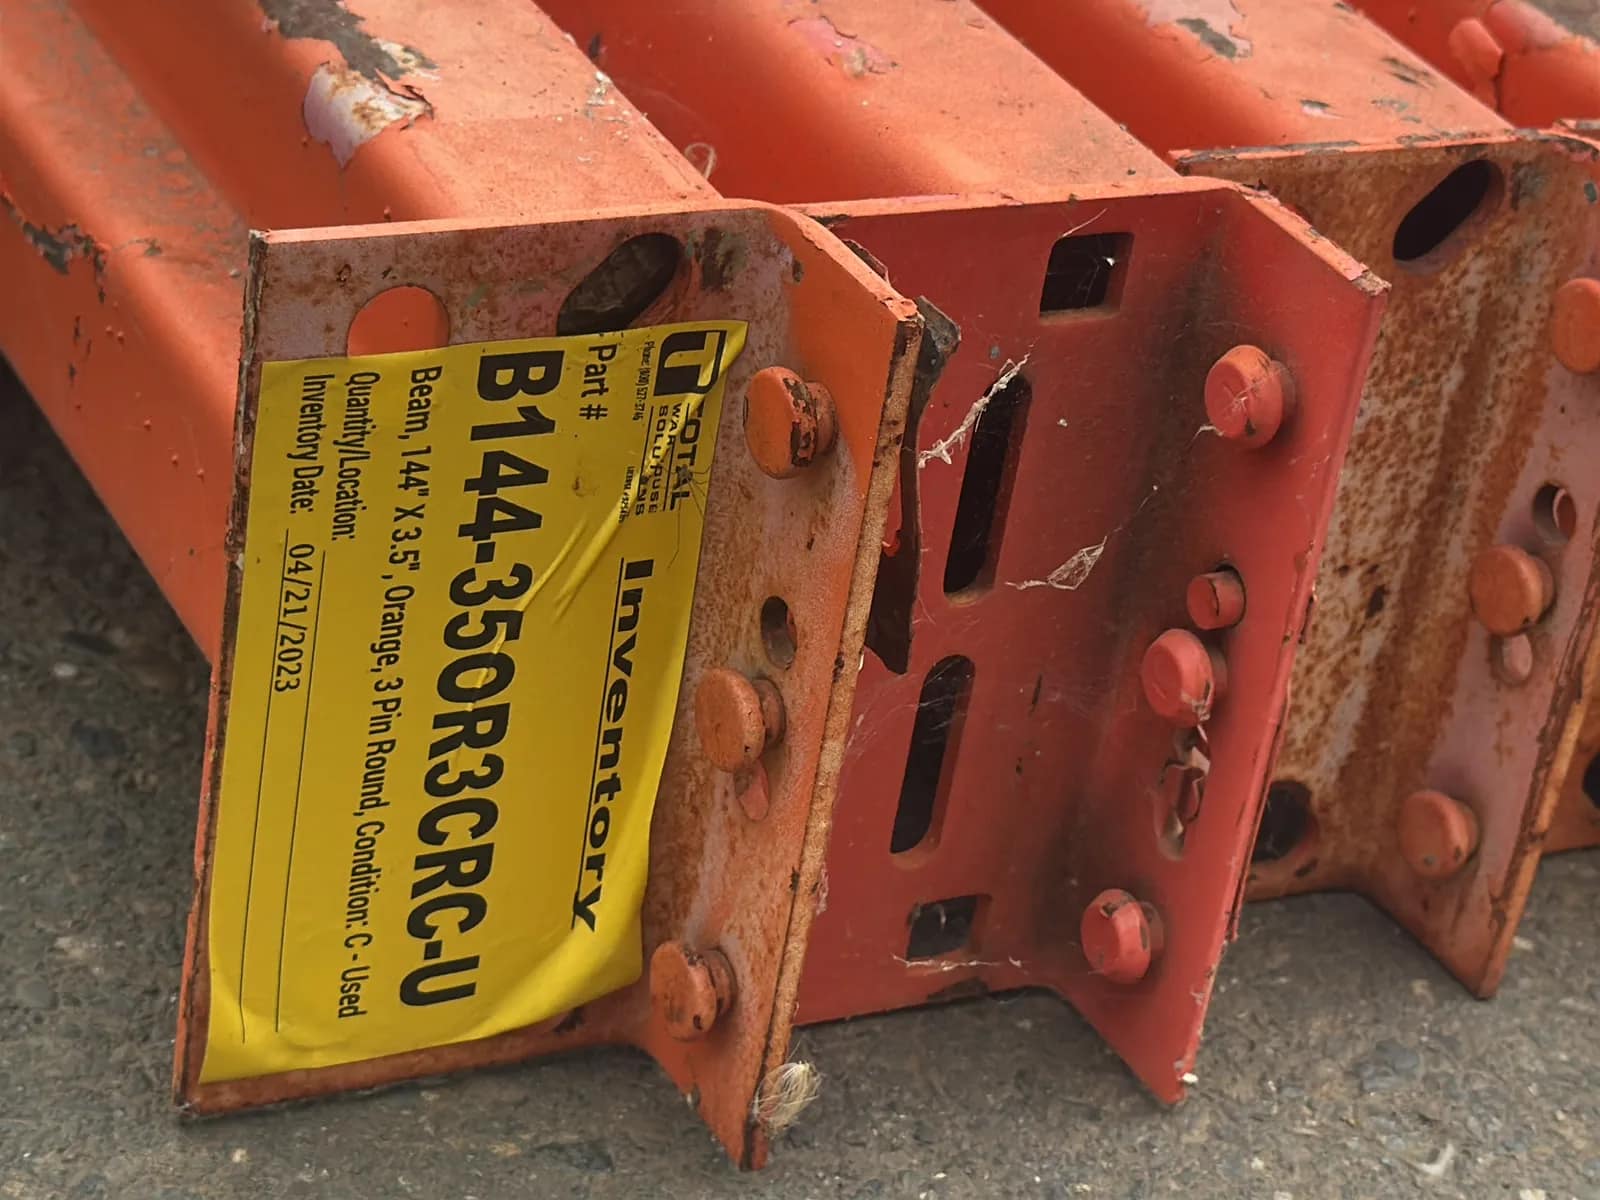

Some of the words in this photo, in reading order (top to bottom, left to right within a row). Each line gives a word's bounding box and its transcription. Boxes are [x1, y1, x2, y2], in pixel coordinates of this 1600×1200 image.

[578, 344, 618, 401] Part
[286, 374, 334, 462] Inventory
[398, 365, 443, 441] Beam,
[579, 403, 608, 421] #
[328, 371, 381, 541] Quantity/Location:
[393, 446, 432, 497] 144"
[288, 466, 324, 514] Date:
[391, 506, 423, 522] X
[272, 542, 318, 694] 04/21/2023
[369, 585, 414, 673] Orange,
[373, 679, 403, 693] 3
[366, 699, 403, 735] Pin
[572, 558, 655, 932] Inventory
[353, 741, 396, 818] Round,
[344, 821, 386, 929] Condition:
[342, 932, 374, 949] C
[336, 968, 370, 1018] Used
